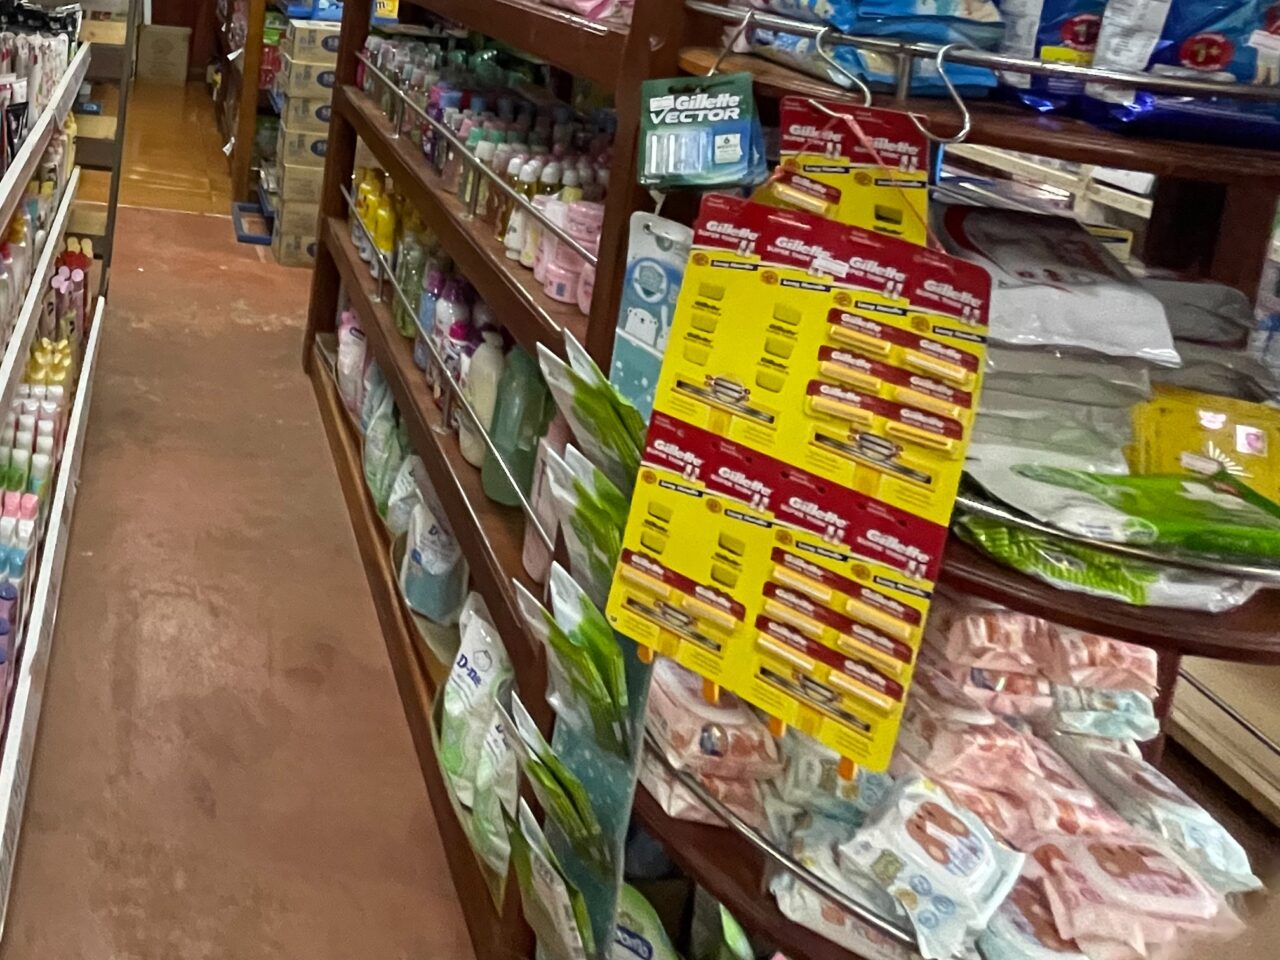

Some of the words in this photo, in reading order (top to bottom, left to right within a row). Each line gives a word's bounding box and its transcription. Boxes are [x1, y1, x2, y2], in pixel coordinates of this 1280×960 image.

[675, 92, 741, 110] Gillette
[650, 108, 740, 125] VECTOR
[706, 220, 760, 241] Gillette
[849, 256, 907, 282] Gillette
[923, 279, 984, 308] Gillette
[653, 439, 705, 467] Gillette
[718, 466, 774, 497] Gillette
[788, 496, 849, 529] Gillette
[866, 528, 931, 564] Gillette
